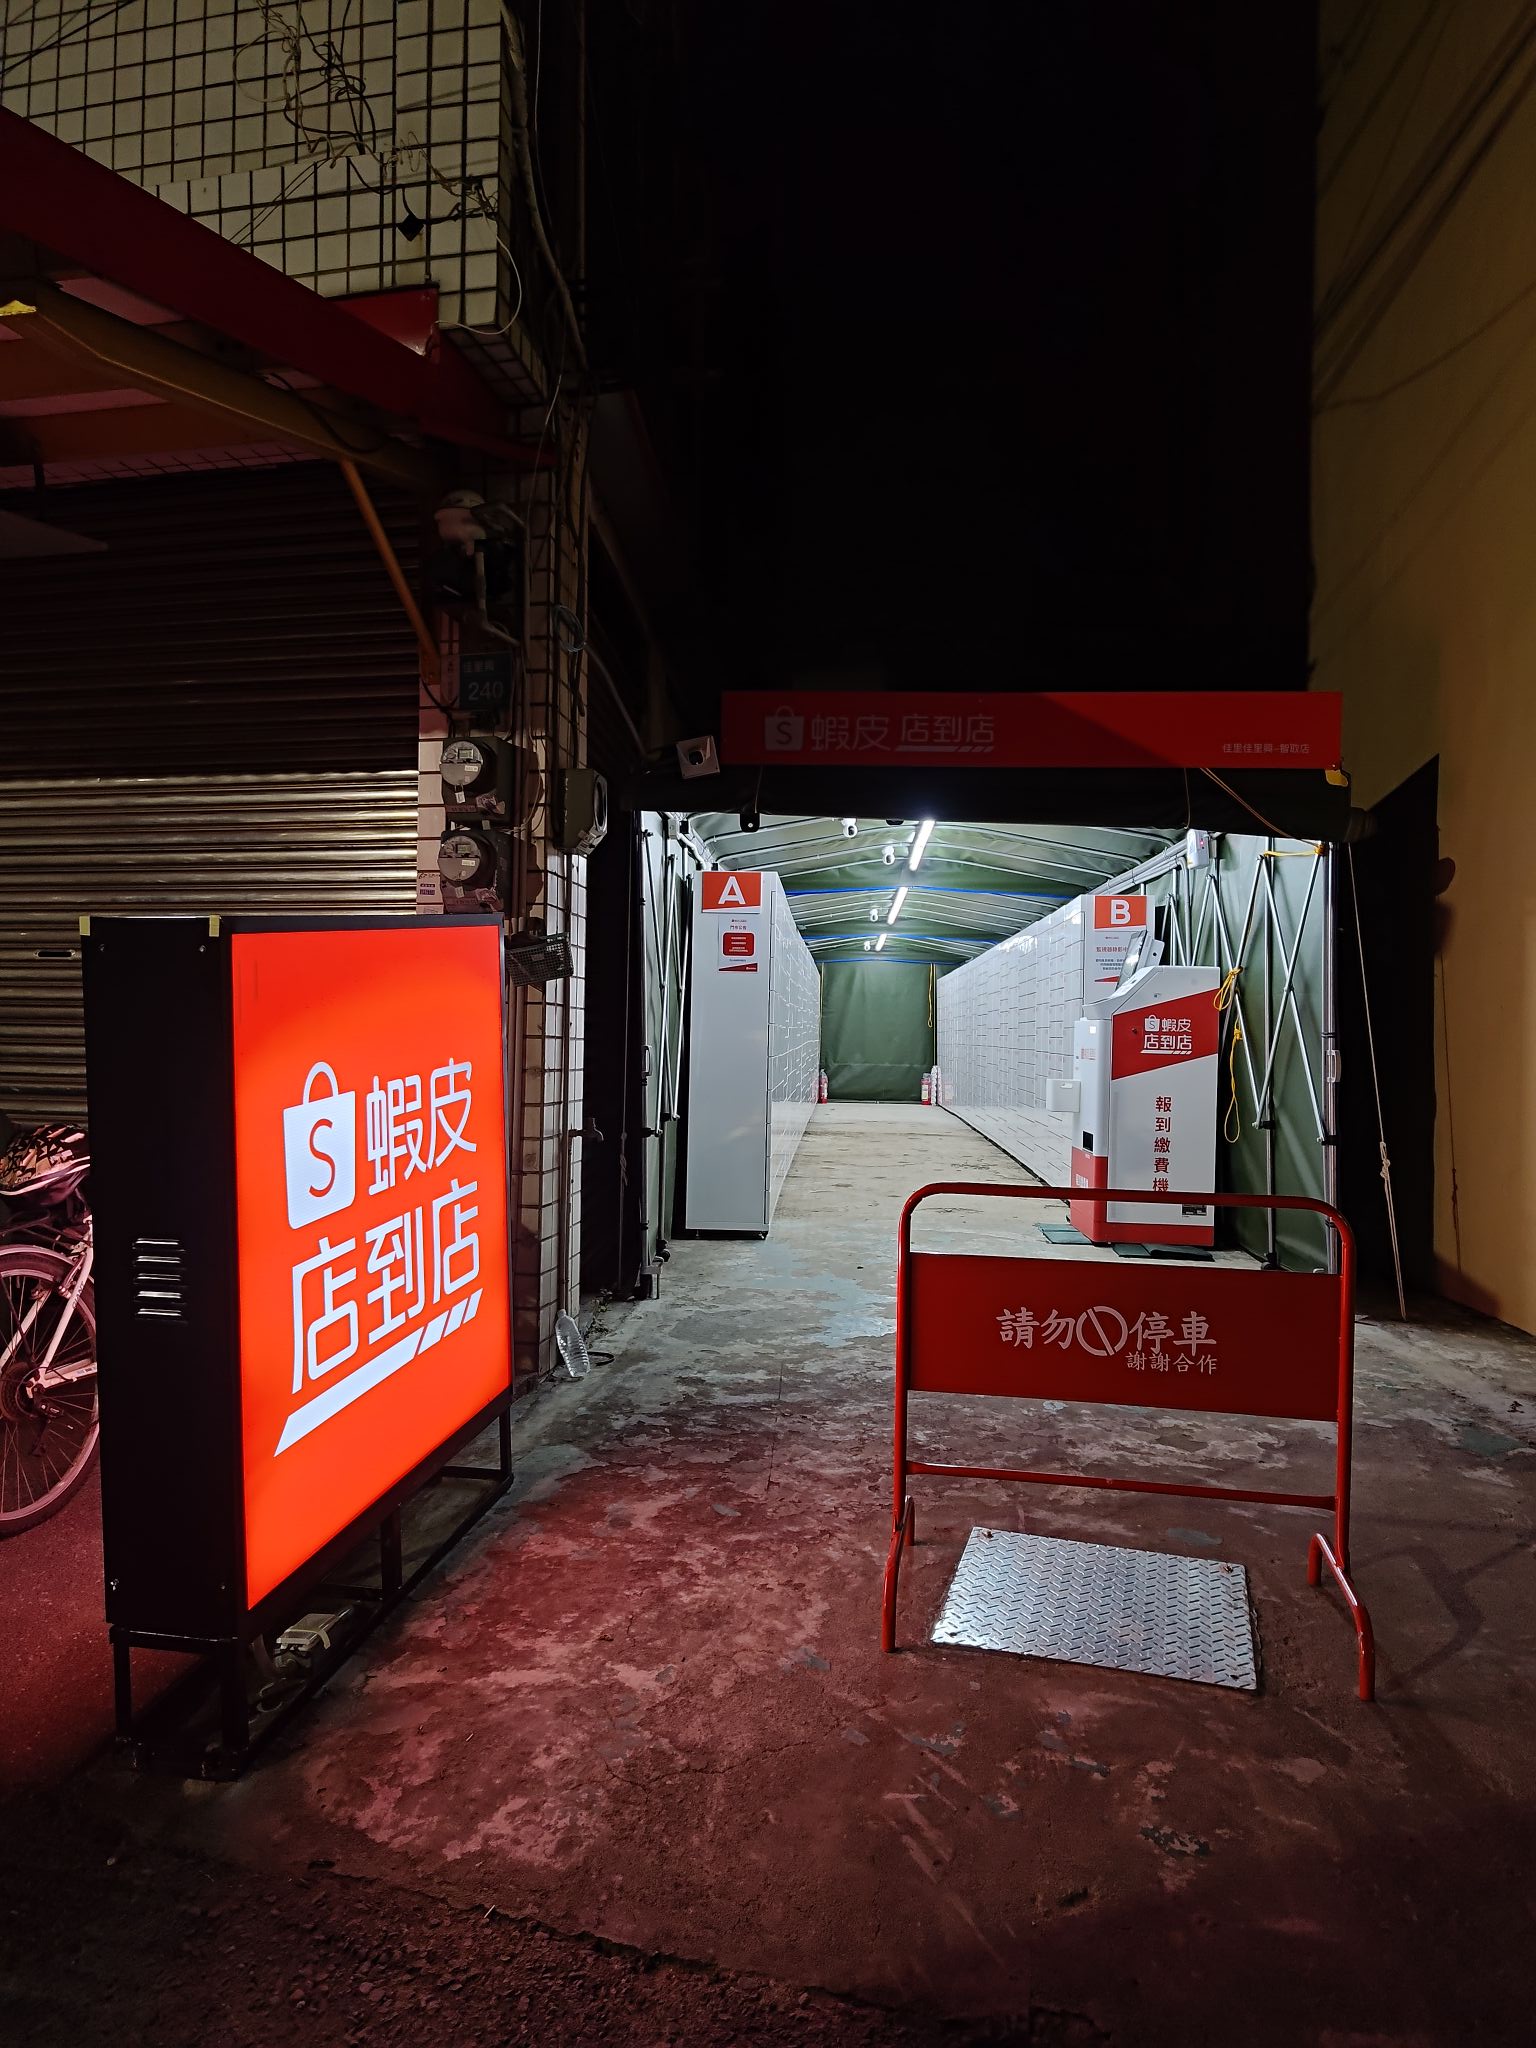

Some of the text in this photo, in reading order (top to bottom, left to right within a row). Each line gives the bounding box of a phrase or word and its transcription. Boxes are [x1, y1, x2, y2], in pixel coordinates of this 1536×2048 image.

[468, 681, 504, 701] 240
[810, 714, 891, 752] 蝦皮
[900, 712, 994, 744] 店到店
[718, 876, 746, 905] A
[1110, 899, 1131, 925] B
[1161, 1018, 1192, 1033] 蝦皮
[1143, 1034, 1192, 1050] 店到店
[366, 1057, 477, 1196] 蝦皮
[1152, 1096, 1172, 1192] 報到繳費機
[291, 1178, 480, 1394] 店到店
[996, 1306, 1217, 1357] 請勿 停車
[1125, 1350, 1218, 1376] 謝謝合作
